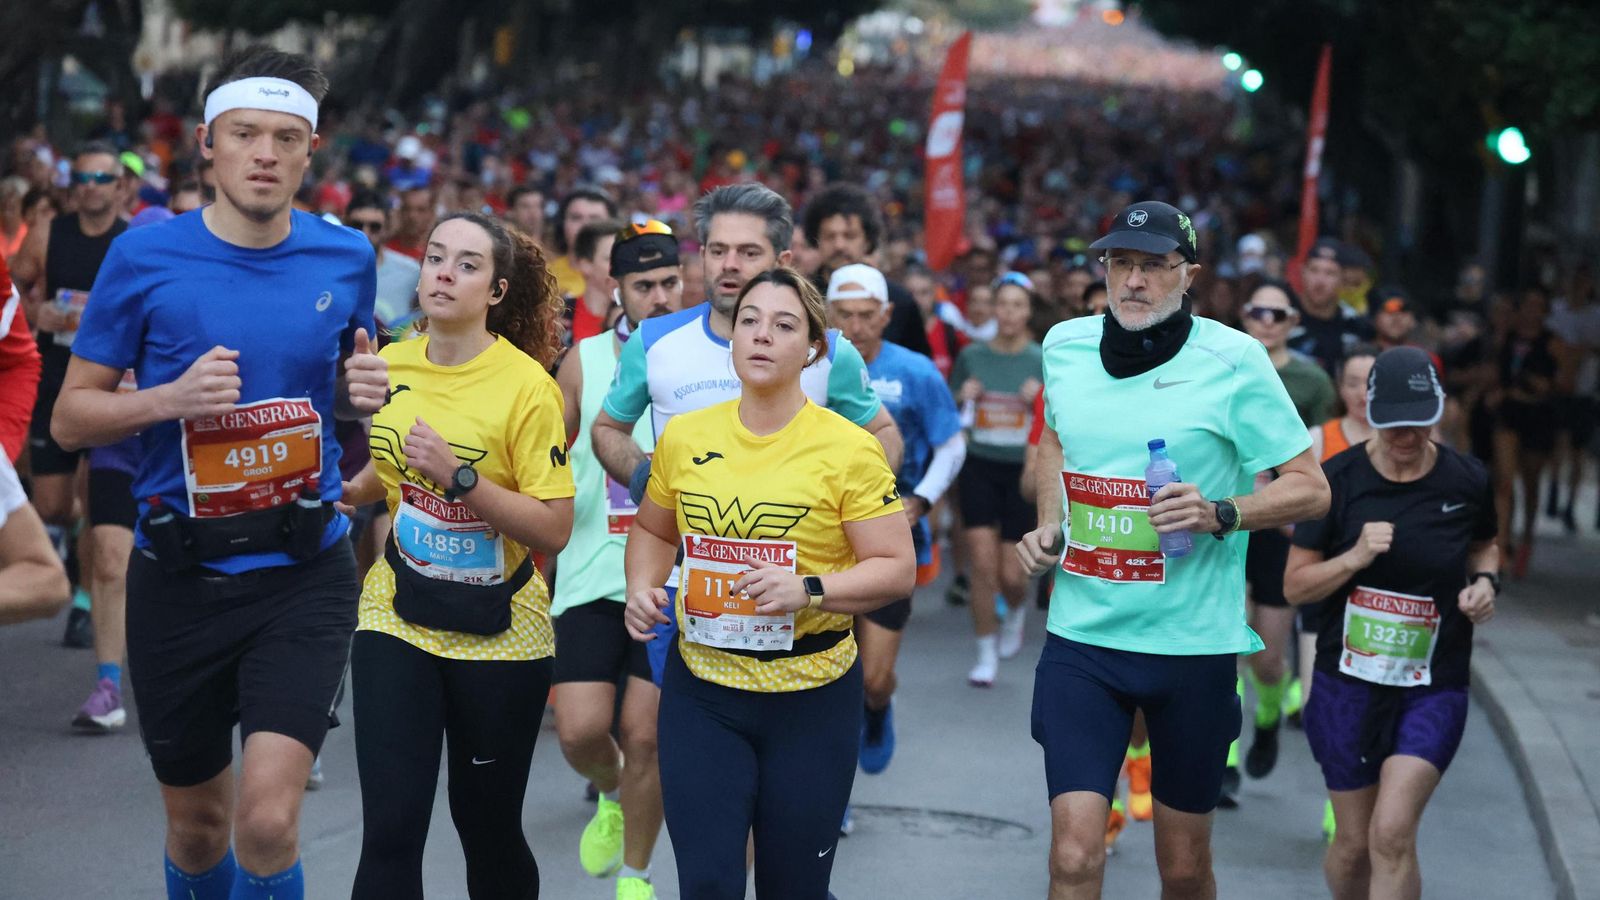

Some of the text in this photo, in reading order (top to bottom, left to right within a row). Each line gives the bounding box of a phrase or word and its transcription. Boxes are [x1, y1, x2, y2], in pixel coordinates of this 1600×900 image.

[673, 380, 717, 400] ASSOCIATION
[224, 442, 288, 468] 4919
[243, 466, 273, 477] GROOT
[1086, 479, 1150, 498] GENERAL
[424, 496, 478, 520] GENERA
[1087, 512, 1133, 534] 1410
[413, 526, 476, 554] 14859
[710, 543, 785, 563] GENERALI
[1126, 558, 1147, 566] 42K
[723, 601, 740, 609] KELI
[1363, 622, 1419, 647] 13237
